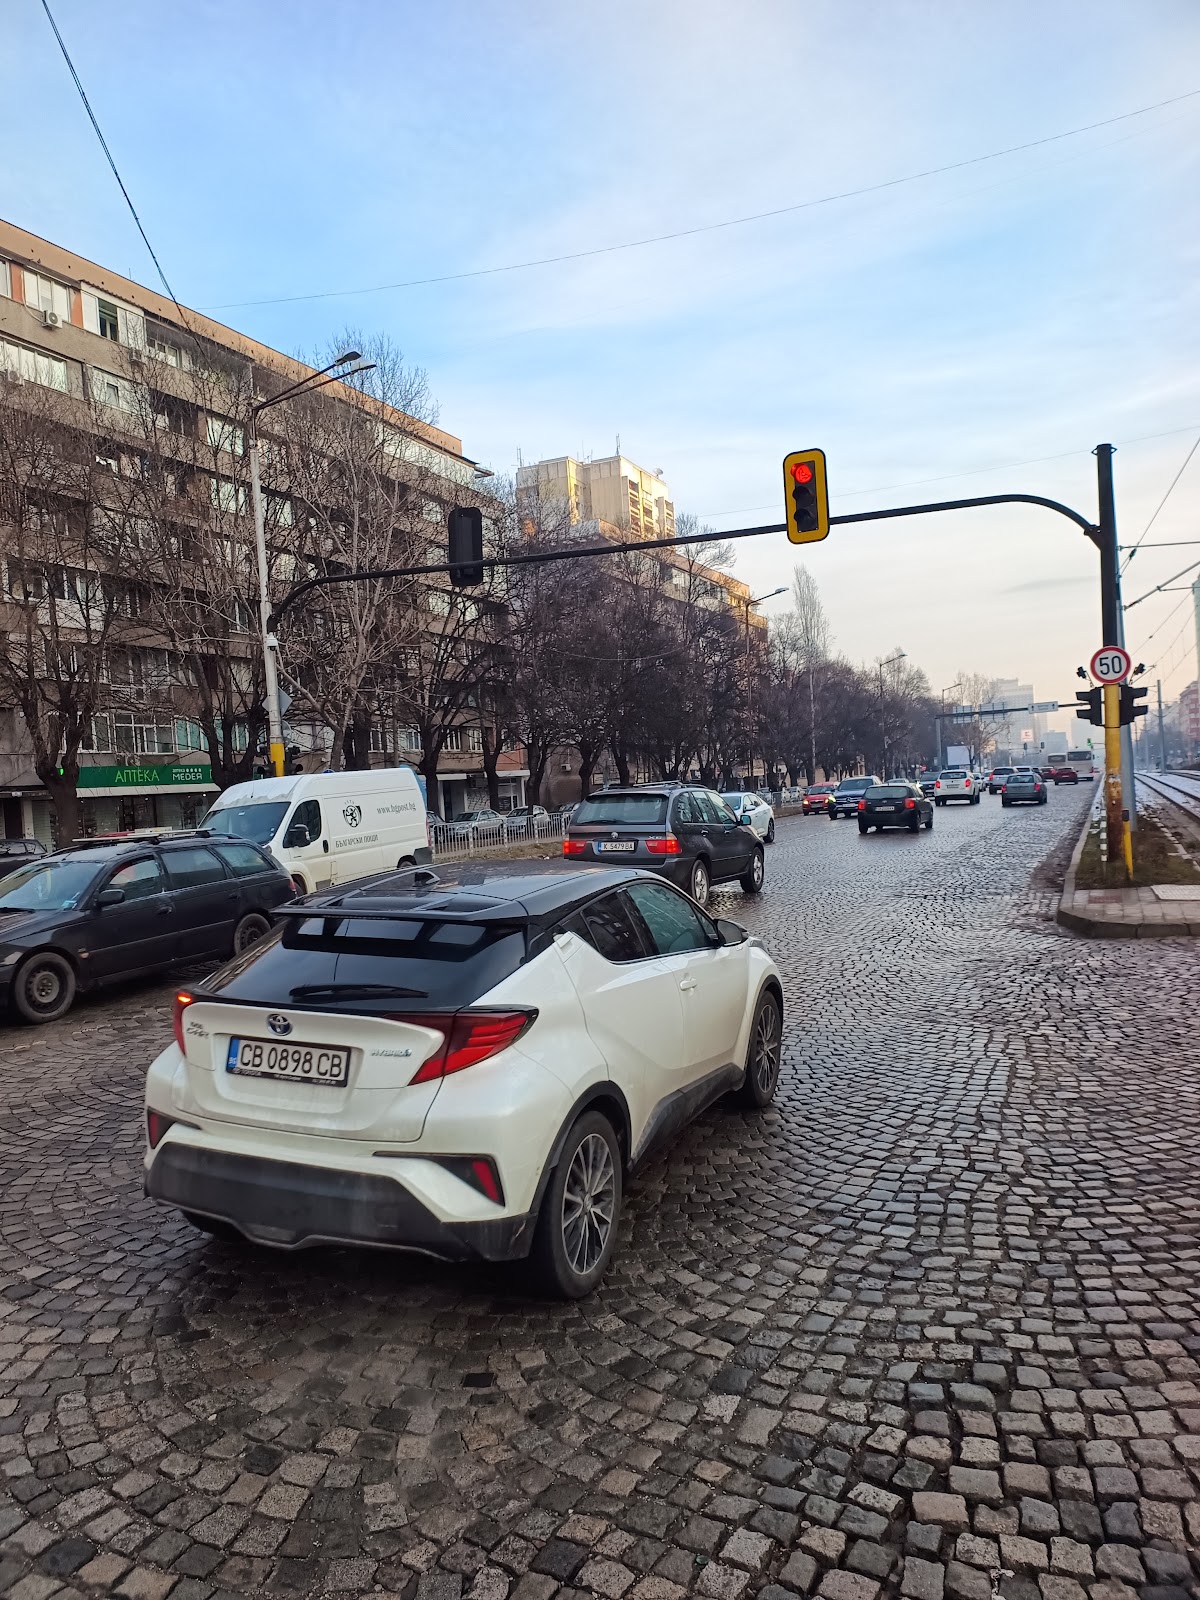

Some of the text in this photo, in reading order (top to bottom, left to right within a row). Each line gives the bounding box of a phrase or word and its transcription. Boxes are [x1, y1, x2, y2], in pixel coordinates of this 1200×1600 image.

[1099, 656, 1122, 675] 50
[115, 769, 160, 782] АПТЕКА
[377, 802, 416, 814] www.bgpost.bg
[335, 836, 363, 848] БЪЛГАРСКИ
[240, 1043, 342, 1078] CB 0898 CB
